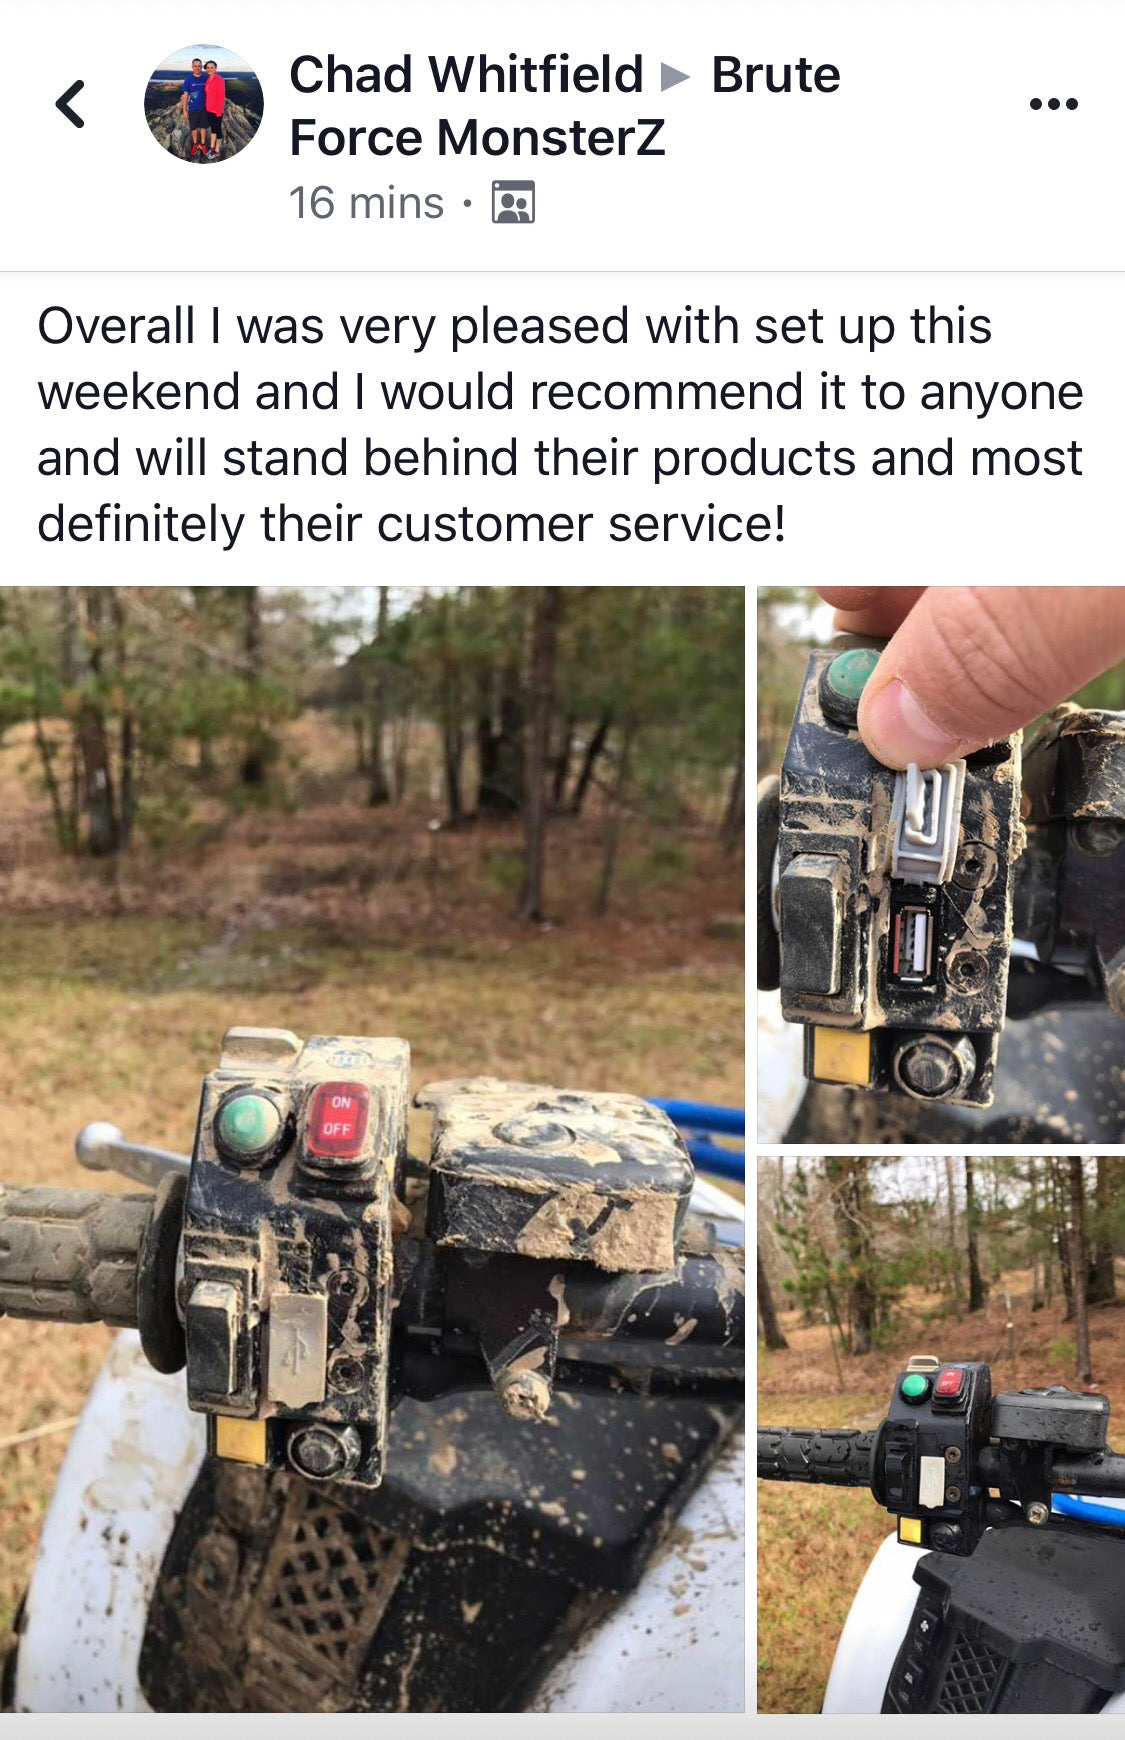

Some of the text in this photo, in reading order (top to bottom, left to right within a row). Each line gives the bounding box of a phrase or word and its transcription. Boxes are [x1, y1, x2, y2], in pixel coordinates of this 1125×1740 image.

[290, 52, 841, 94] Chad Whitfield Brute
[291, 118, 666, 157] Force MonsterZ
[290, 184, 444, 220] 16 mins
[38, 304, 992, 354] Overall I was very pleased with set up this
[37, 370, 1084, 420] weekend and I would recommend it to anyone
[37, 436, 1083, 485] and will stand behind their products and most
[38, 502, 784, 552] definitely their customer service!
[332, 1096, 351, 1108] ON
[323, 1122, 352, 1135] OFF
